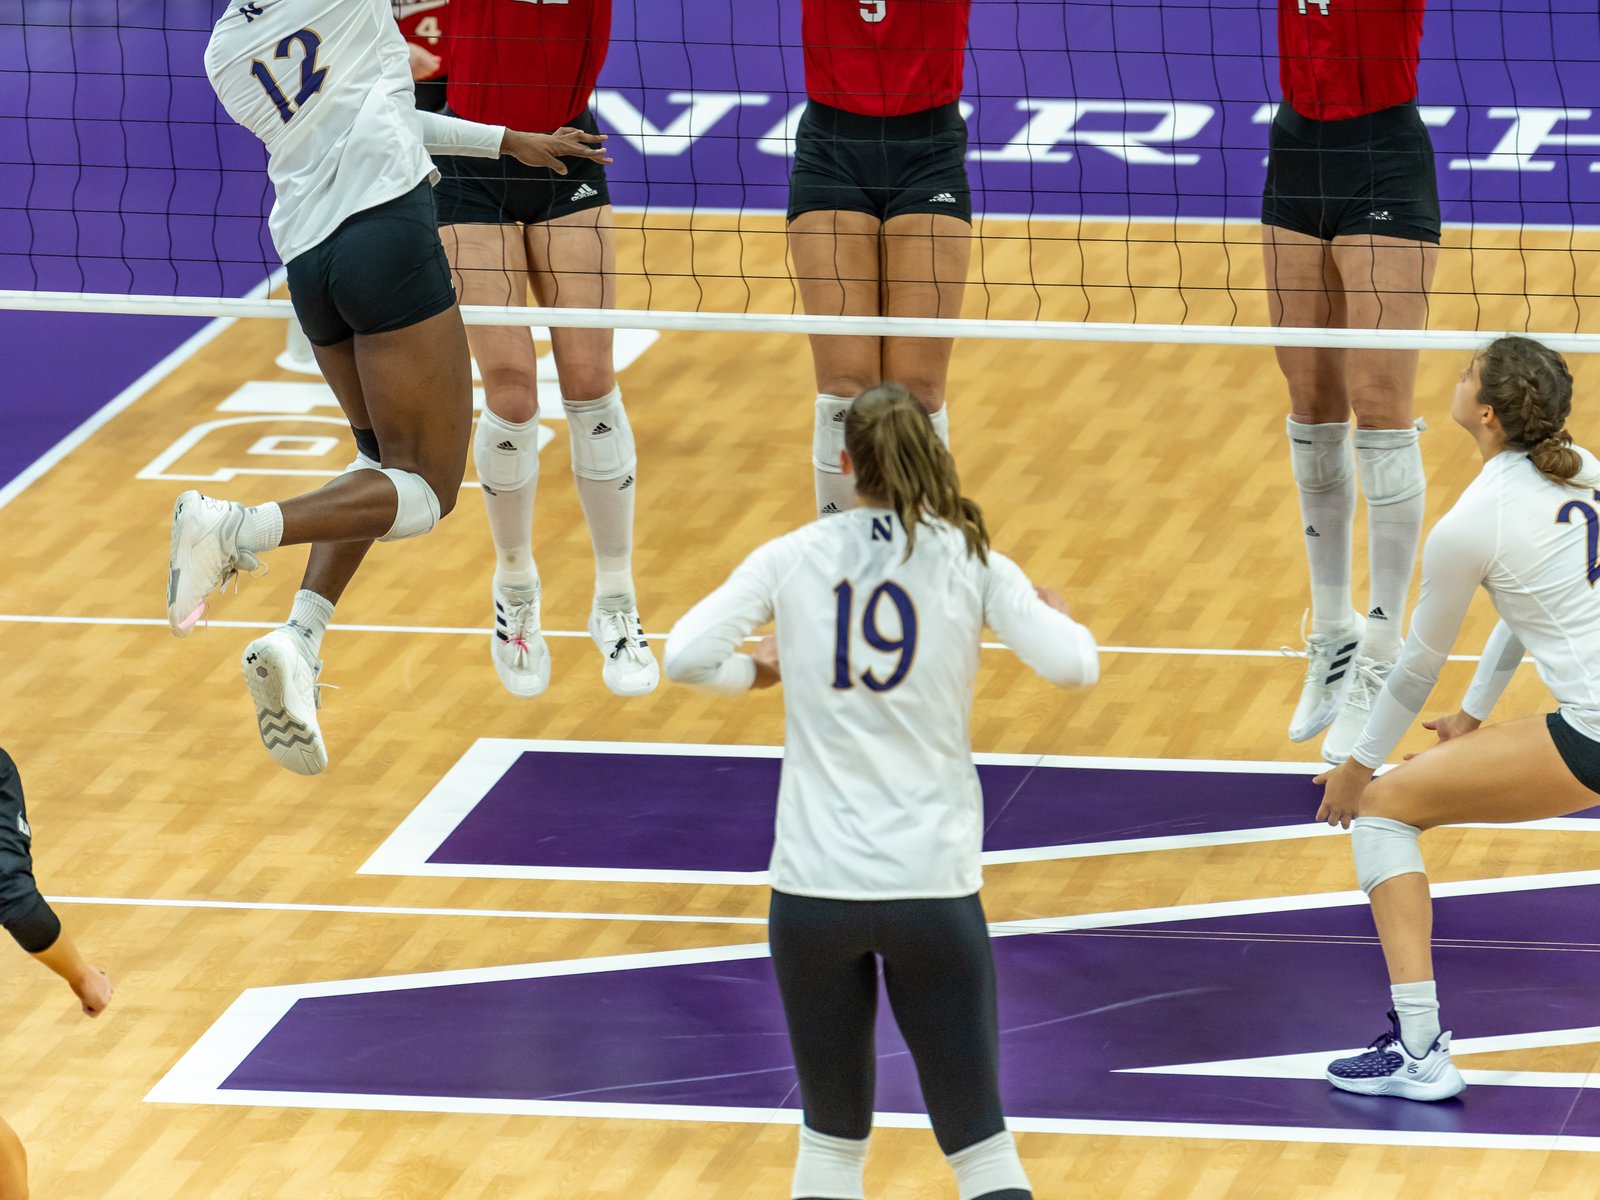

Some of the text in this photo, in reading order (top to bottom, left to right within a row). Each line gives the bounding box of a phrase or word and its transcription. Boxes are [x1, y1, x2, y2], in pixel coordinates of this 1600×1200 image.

[250, 27, 330, 126] 12
[415, 16, 441, 45] 4
[871, 514, 893, 543] N
[1554, 490, 1600, 589] 2
[832, 577, 919, 693] 19
